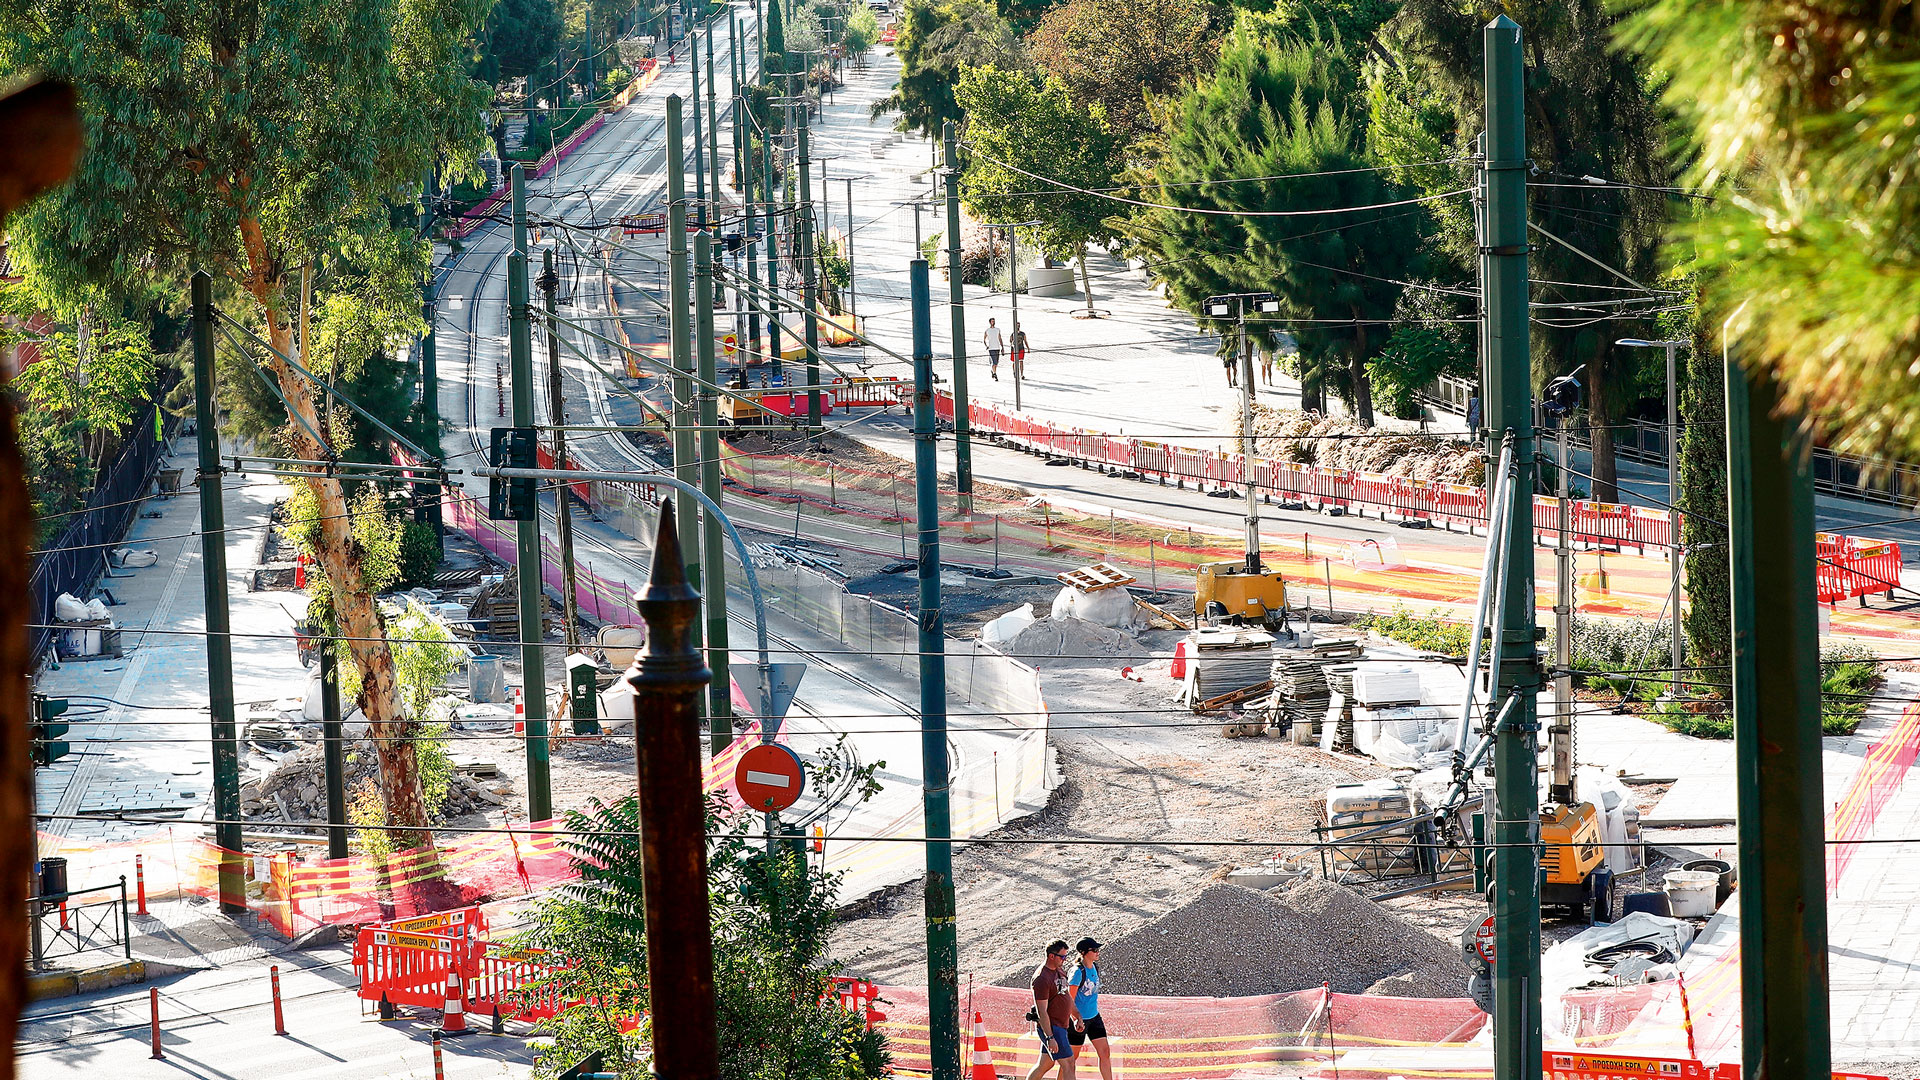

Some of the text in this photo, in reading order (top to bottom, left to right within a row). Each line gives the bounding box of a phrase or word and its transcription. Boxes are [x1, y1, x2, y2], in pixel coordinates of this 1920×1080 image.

[405, 918, 438, 931] ΠΡΟΣΟΧΗ ΕΡΓΑ
[398, 936, 418, 946] ΠΡΟΣΟΧΗ
[418, 938, 429, 947] ΕΡΓΑ
[1592, 1059, 1642, 1072] ΠΡΟΣΟΧΗ ΕΡΓΑ
